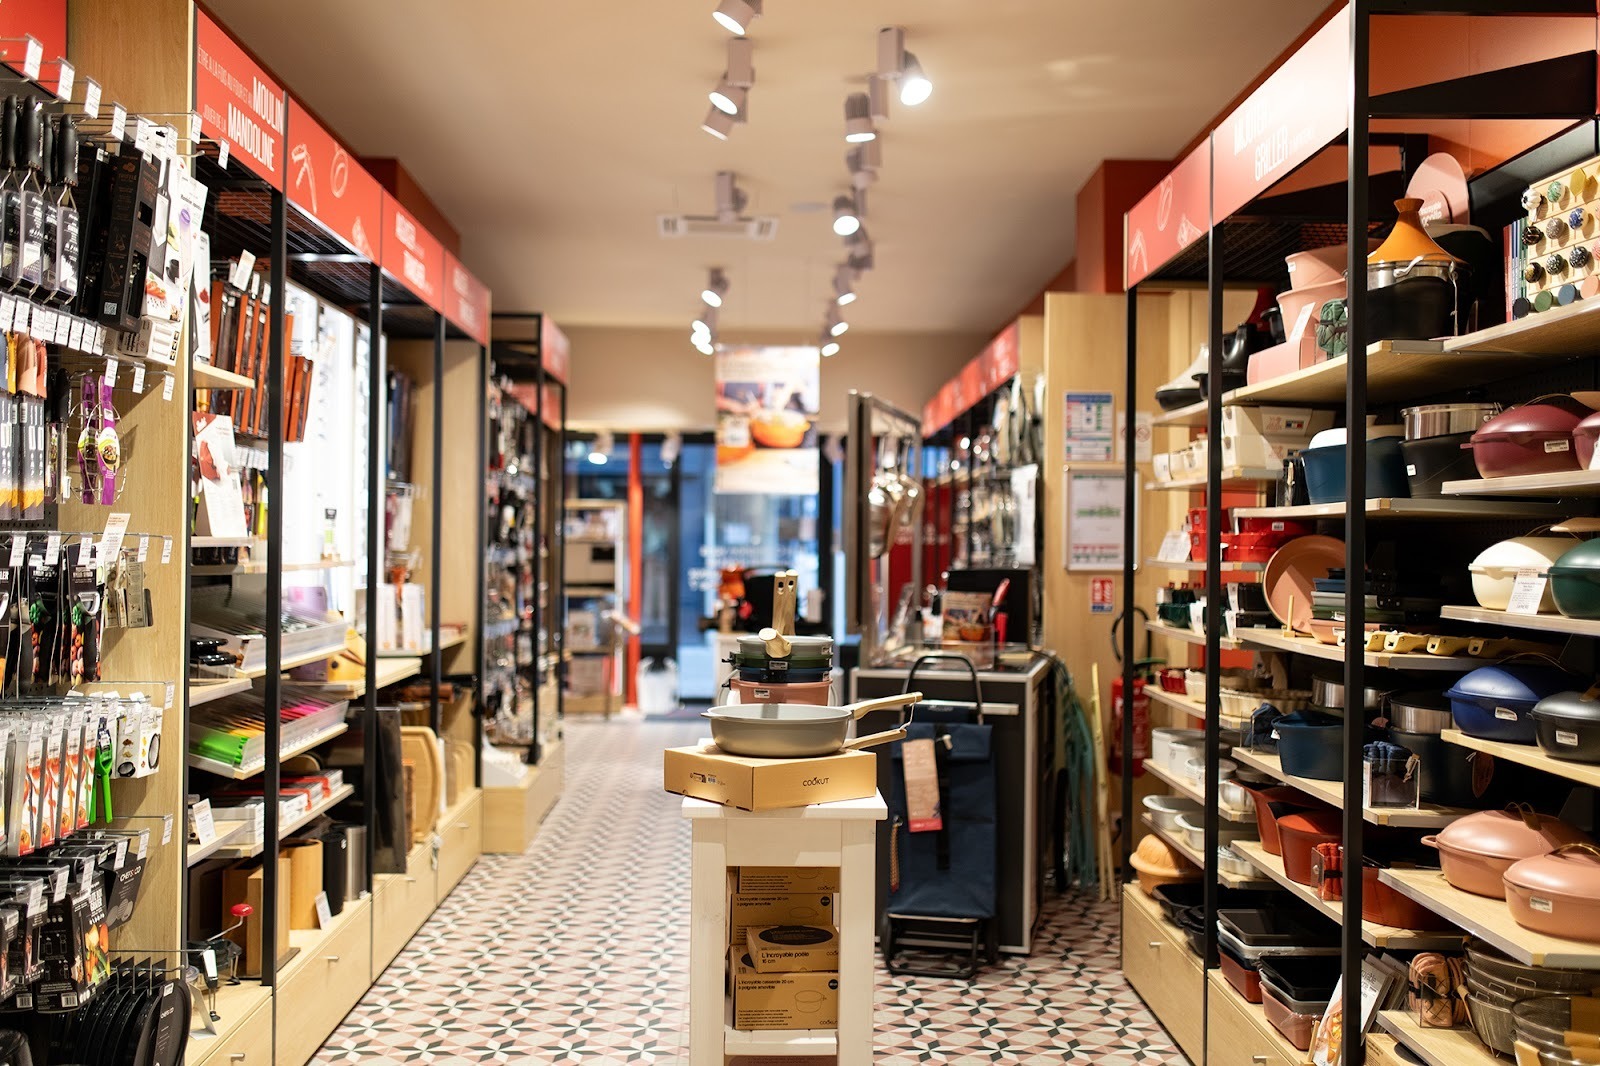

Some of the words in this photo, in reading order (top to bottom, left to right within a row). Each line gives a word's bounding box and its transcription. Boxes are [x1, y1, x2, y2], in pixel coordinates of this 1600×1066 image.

[253, 76, 284, 136] MOULIN
[228, 102, 275, 172] MANDOLINE
[1254, 125, 1289, 182] GRILLER
[803, 776, 830, 787] COOKUT
[761, 951, 793, 959] L'incroyable
